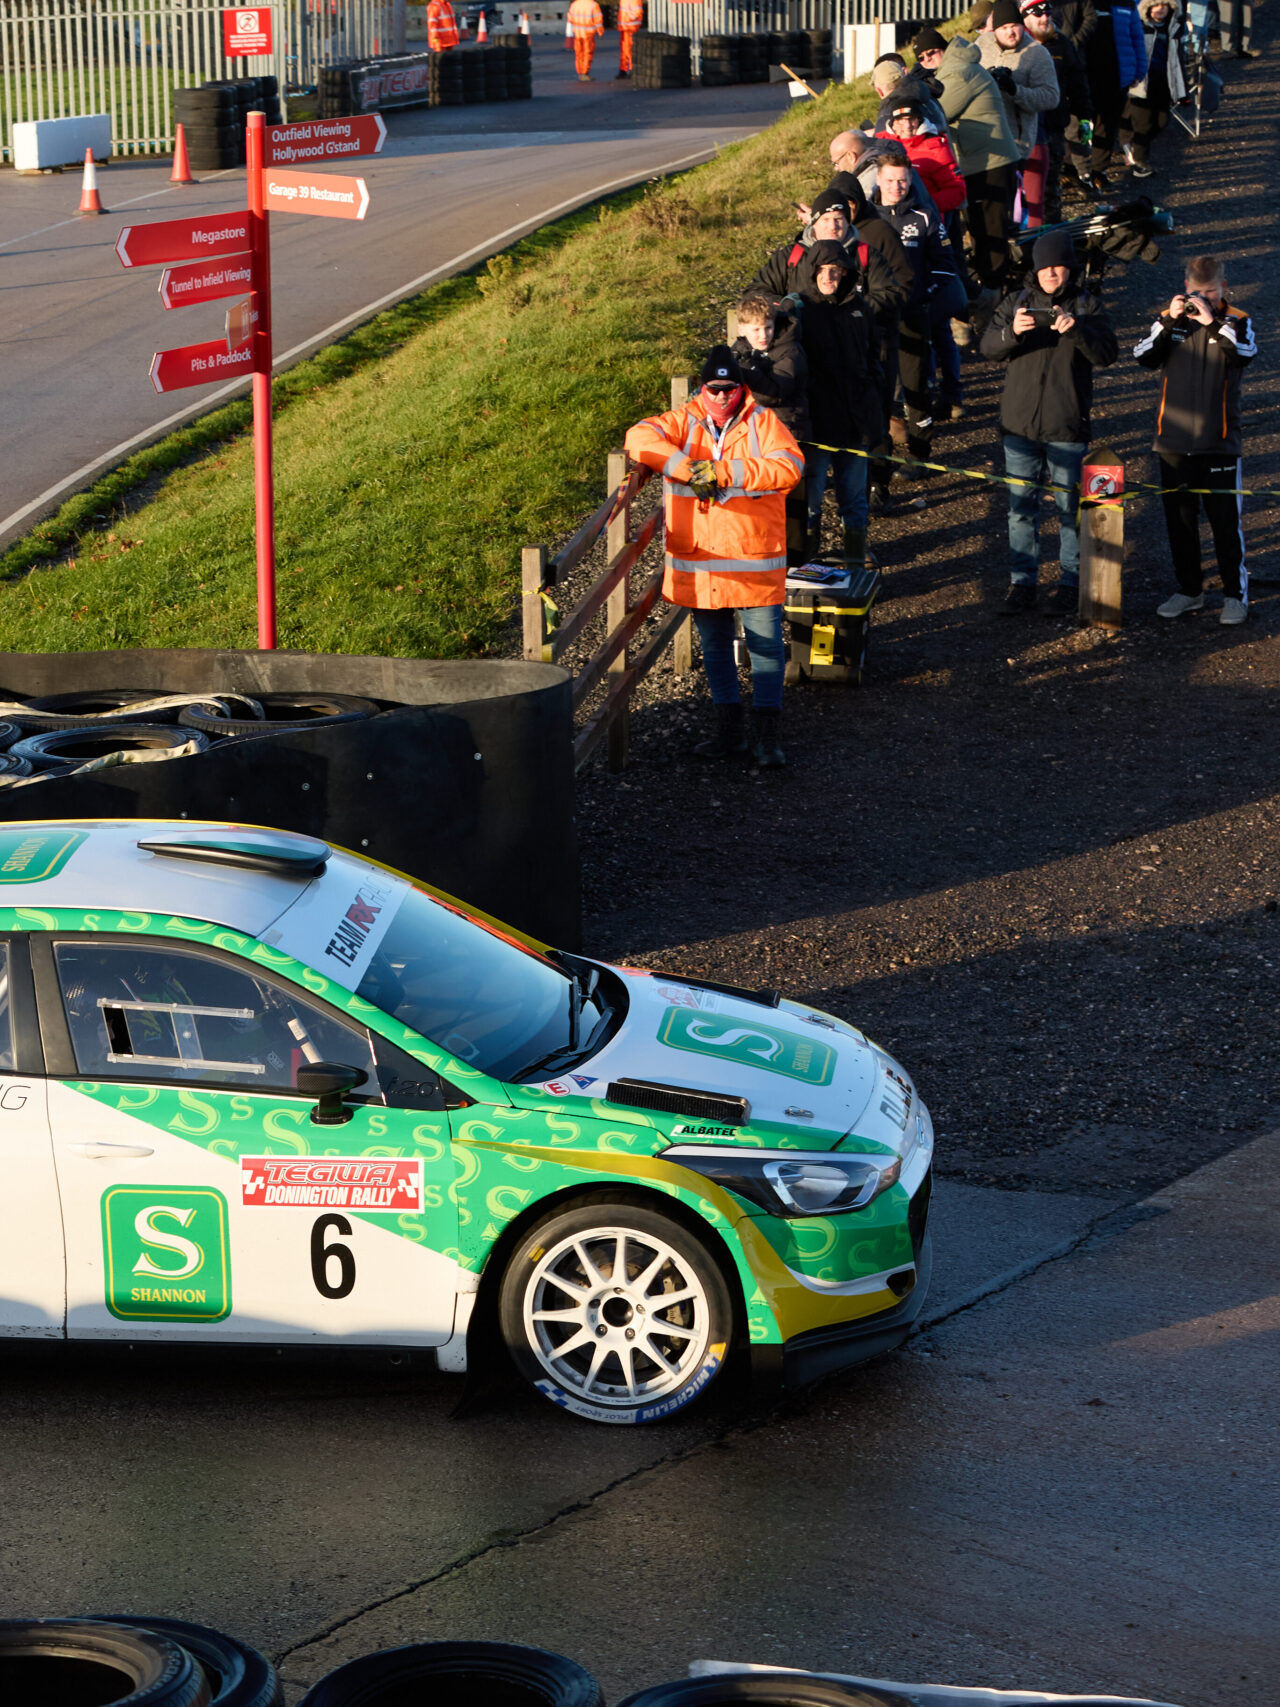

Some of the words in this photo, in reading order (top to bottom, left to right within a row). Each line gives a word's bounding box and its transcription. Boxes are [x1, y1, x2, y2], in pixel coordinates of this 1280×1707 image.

[272, 126, 311, 142] Outfield
[313, 122, 351, 137] Viewing
[272, 143, 324, 161] Hollywood
[326, 138, 360, 154] G'stand
[268, 182, 298, 200] Garage
[298, 185, 310, 198] 39
[310, 186, 354, 203] Restaurant
[191, 227, 246, 245] Megastore
[171, 277, 193, 294] Tunnel
[194, 277, 202, 289] to
[203, 270, 224, 288] Infield
[224, 266, 251, 282] Viewing
[191, 358, 207, 371] Pits
[208, 355, 215, 368] &
[216, 348, 251, 366] Paddock
[0, 837, 49, 872] SHANNON
[345, 894, 382, 934] RX
[324, 919, 367, 968] TEAM
[681, 1125, 737, 1137] ALBATEC
[264, 1161, 398, 1185] TEGIWA
[264, 1186, 350, 1205] DONINGTON
[350, 1187, 397, 1207] RALLY
[131, 1205, 205, 1280] S
[310, 1213, 357, 1300] 6
[131, 1287, 207, 1304] SHANNON
[642, 1369, 710, 1420] MICHELIN
